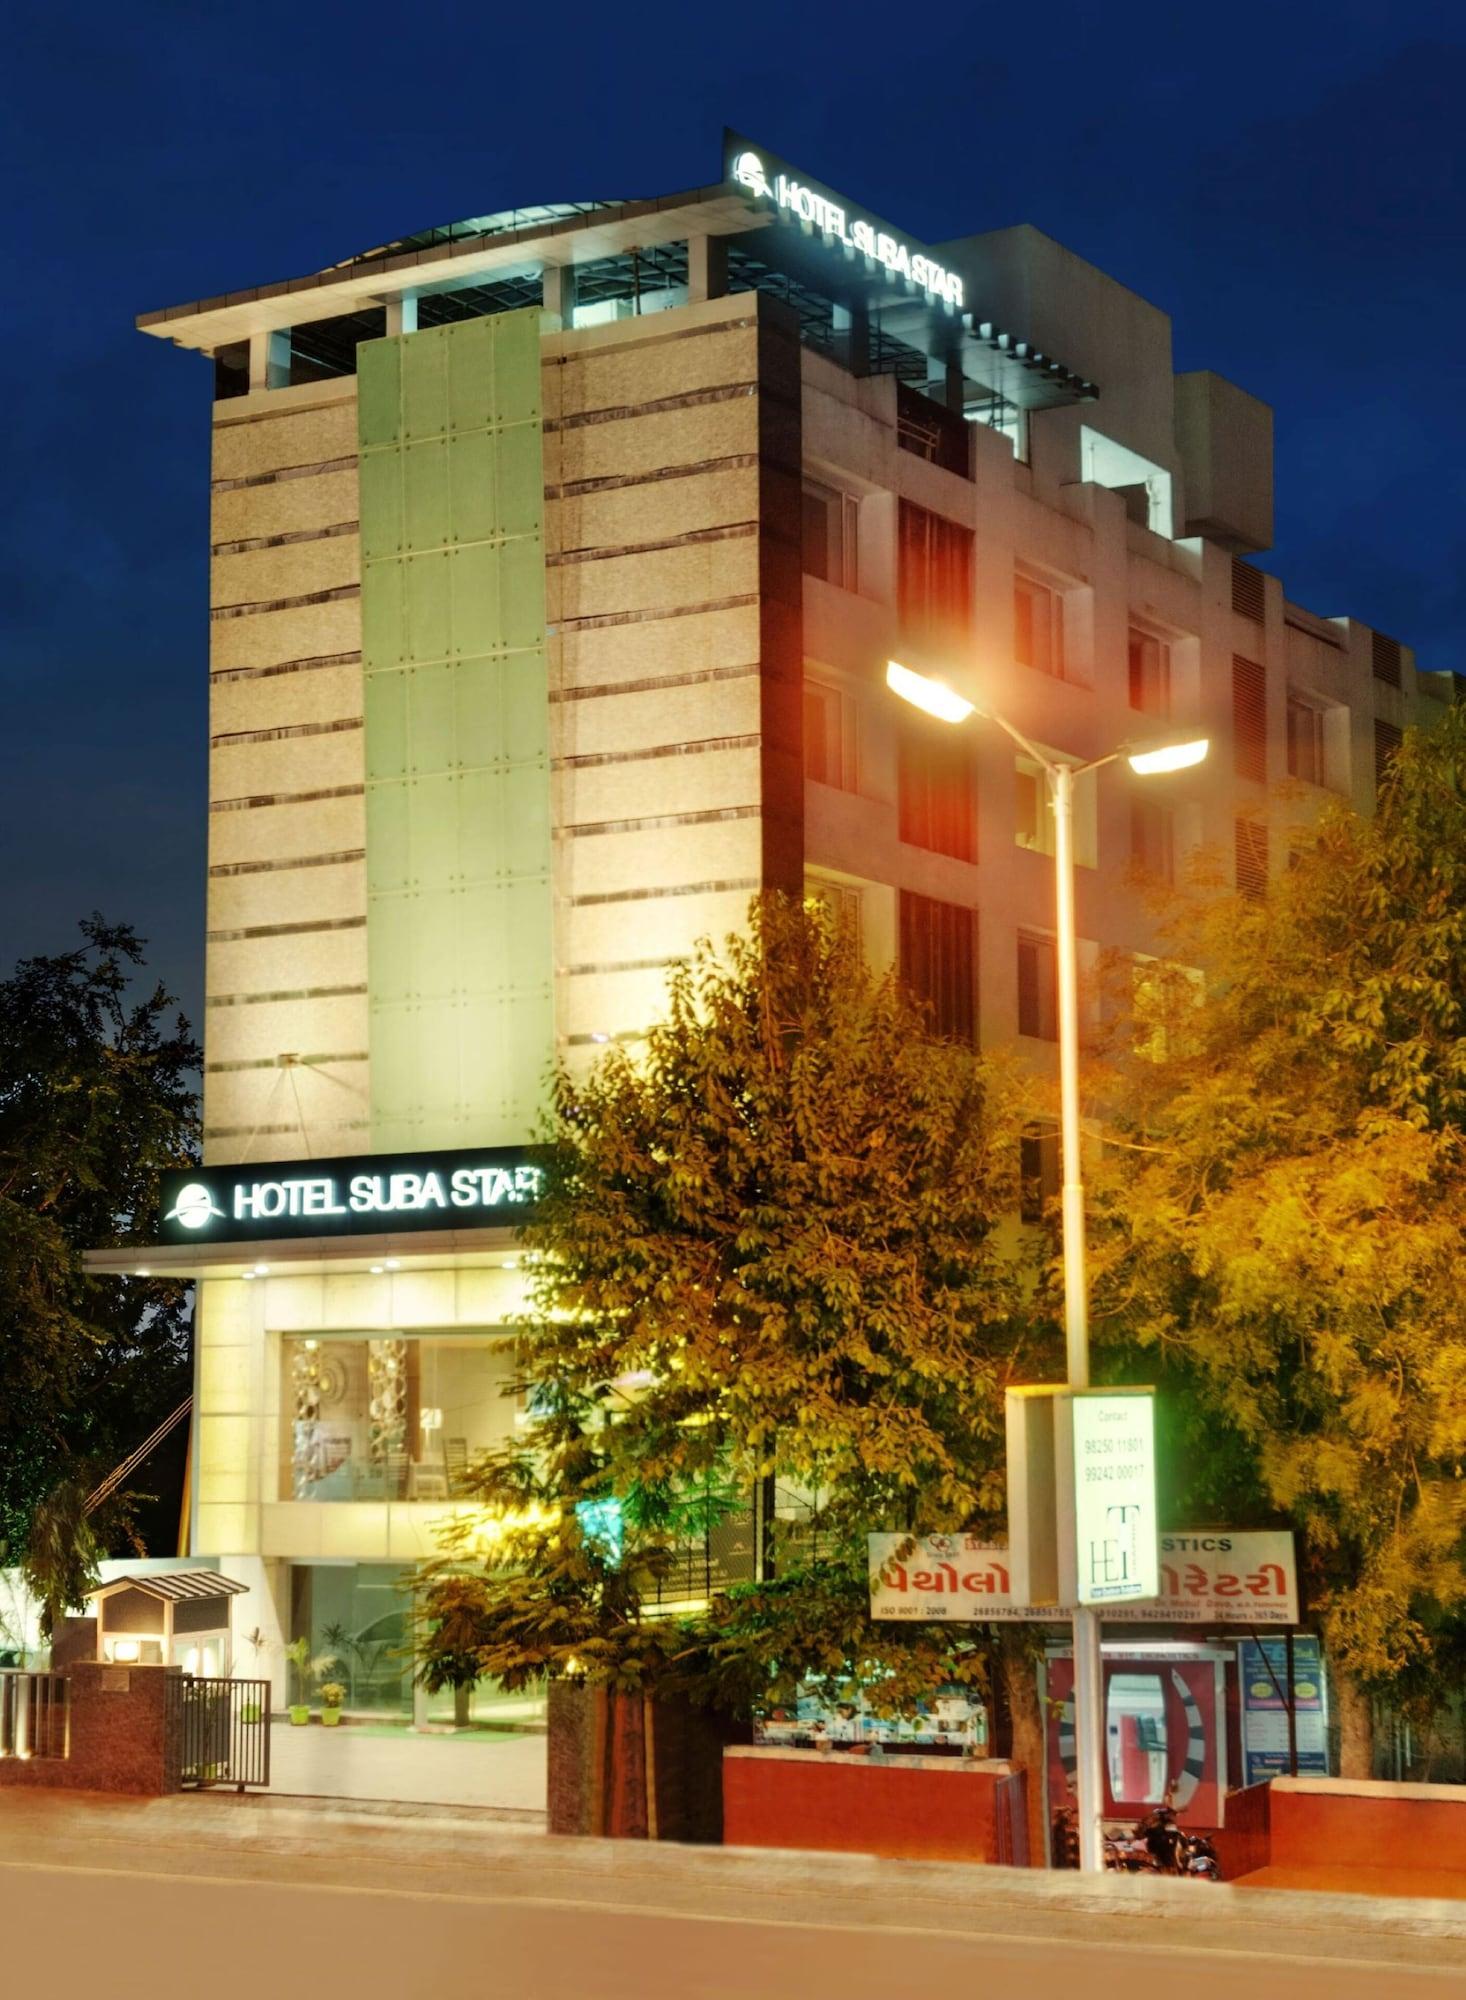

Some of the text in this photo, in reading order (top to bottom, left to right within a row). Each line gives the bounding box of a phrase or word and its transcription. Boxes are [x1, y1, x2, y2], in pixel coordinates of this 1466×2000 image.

[776, 174, 965, 308] HOTEL SUBA STAR
[233, 1166, 542, 1220] HOTEL SUBA STAR
